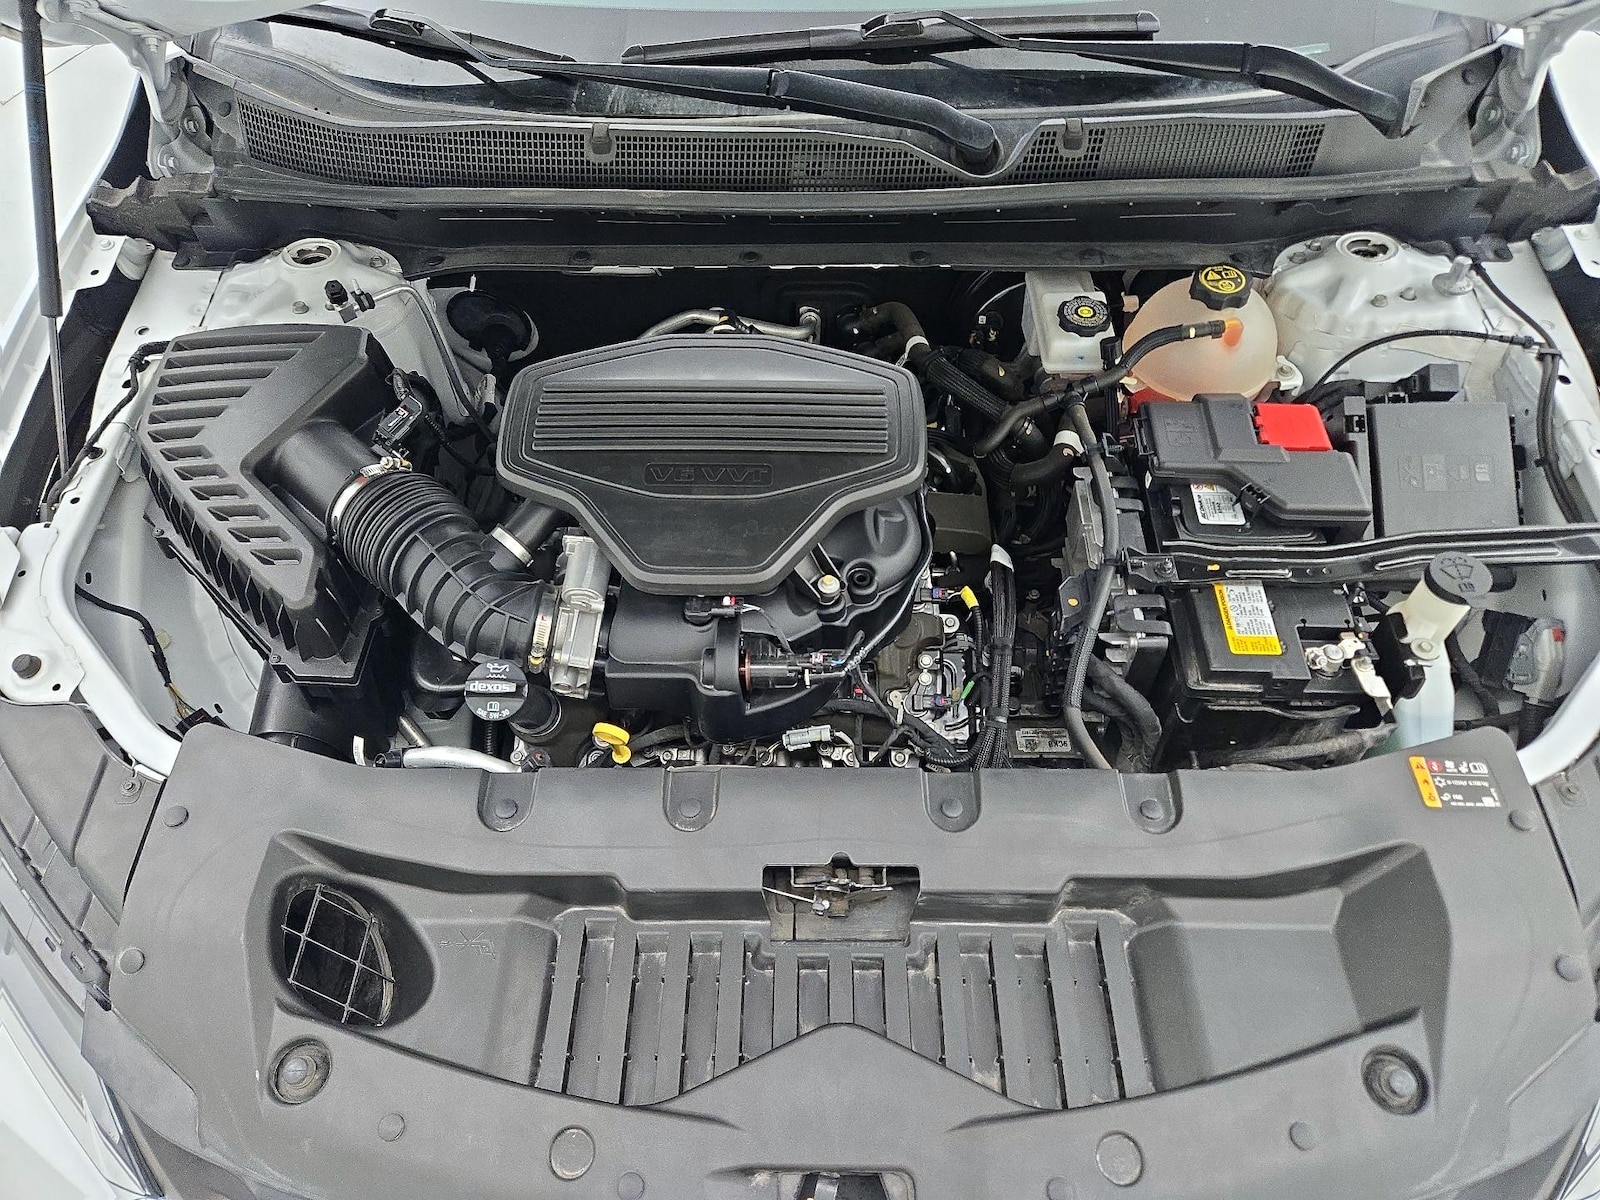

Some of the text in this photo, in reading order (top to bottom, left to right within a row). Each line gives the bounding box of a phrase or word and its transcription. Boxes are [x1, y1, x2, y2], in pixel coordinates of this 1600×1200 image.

[650, 467, 769, 482] V6 VVT
[470, 680, 511, 692] dexos
[476, 707, 510, 719] SAE 5W-30
